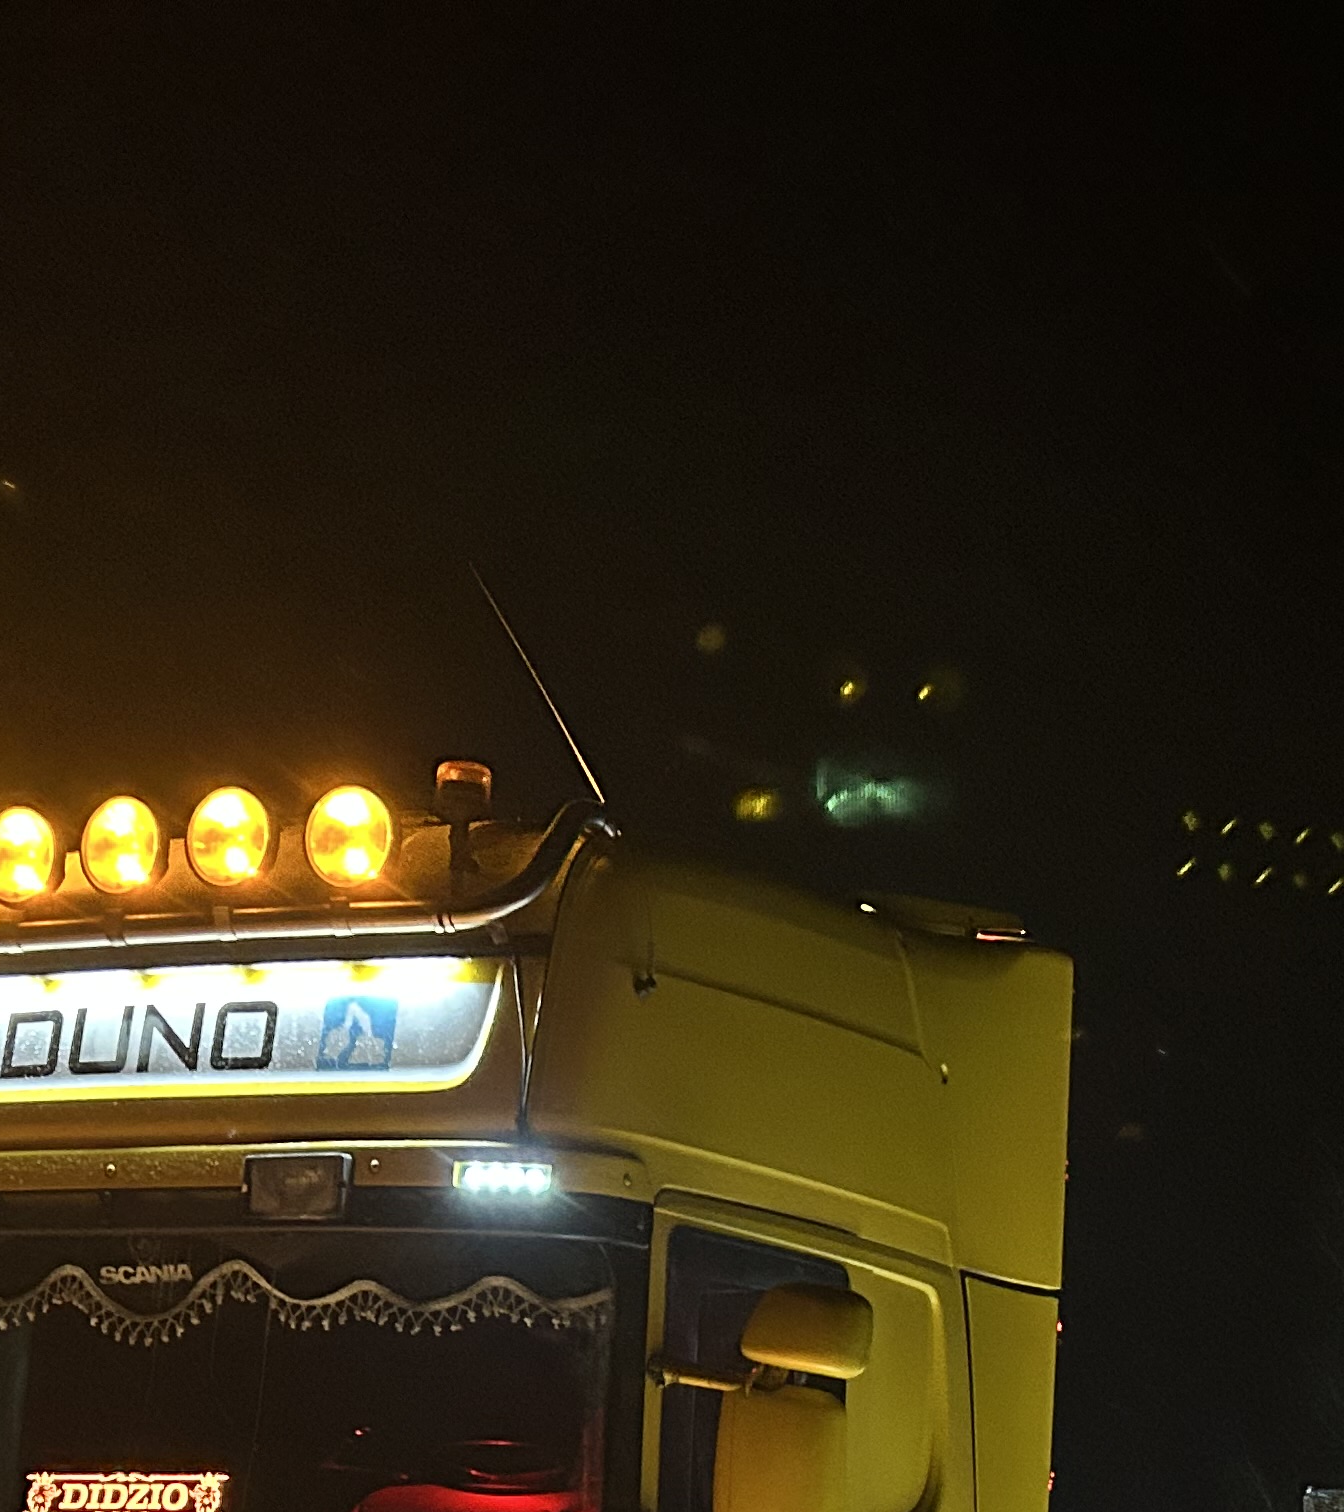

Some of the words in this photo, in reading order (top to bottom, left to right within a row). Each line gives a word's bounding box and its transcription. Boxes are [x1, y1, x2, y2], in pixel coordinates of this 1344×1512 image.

[0, 1001, 278, 1079] DUNO
[99, 1263, 193, 1285] SCANIA
[58, 1482, 189, 1511] DIDZIO
